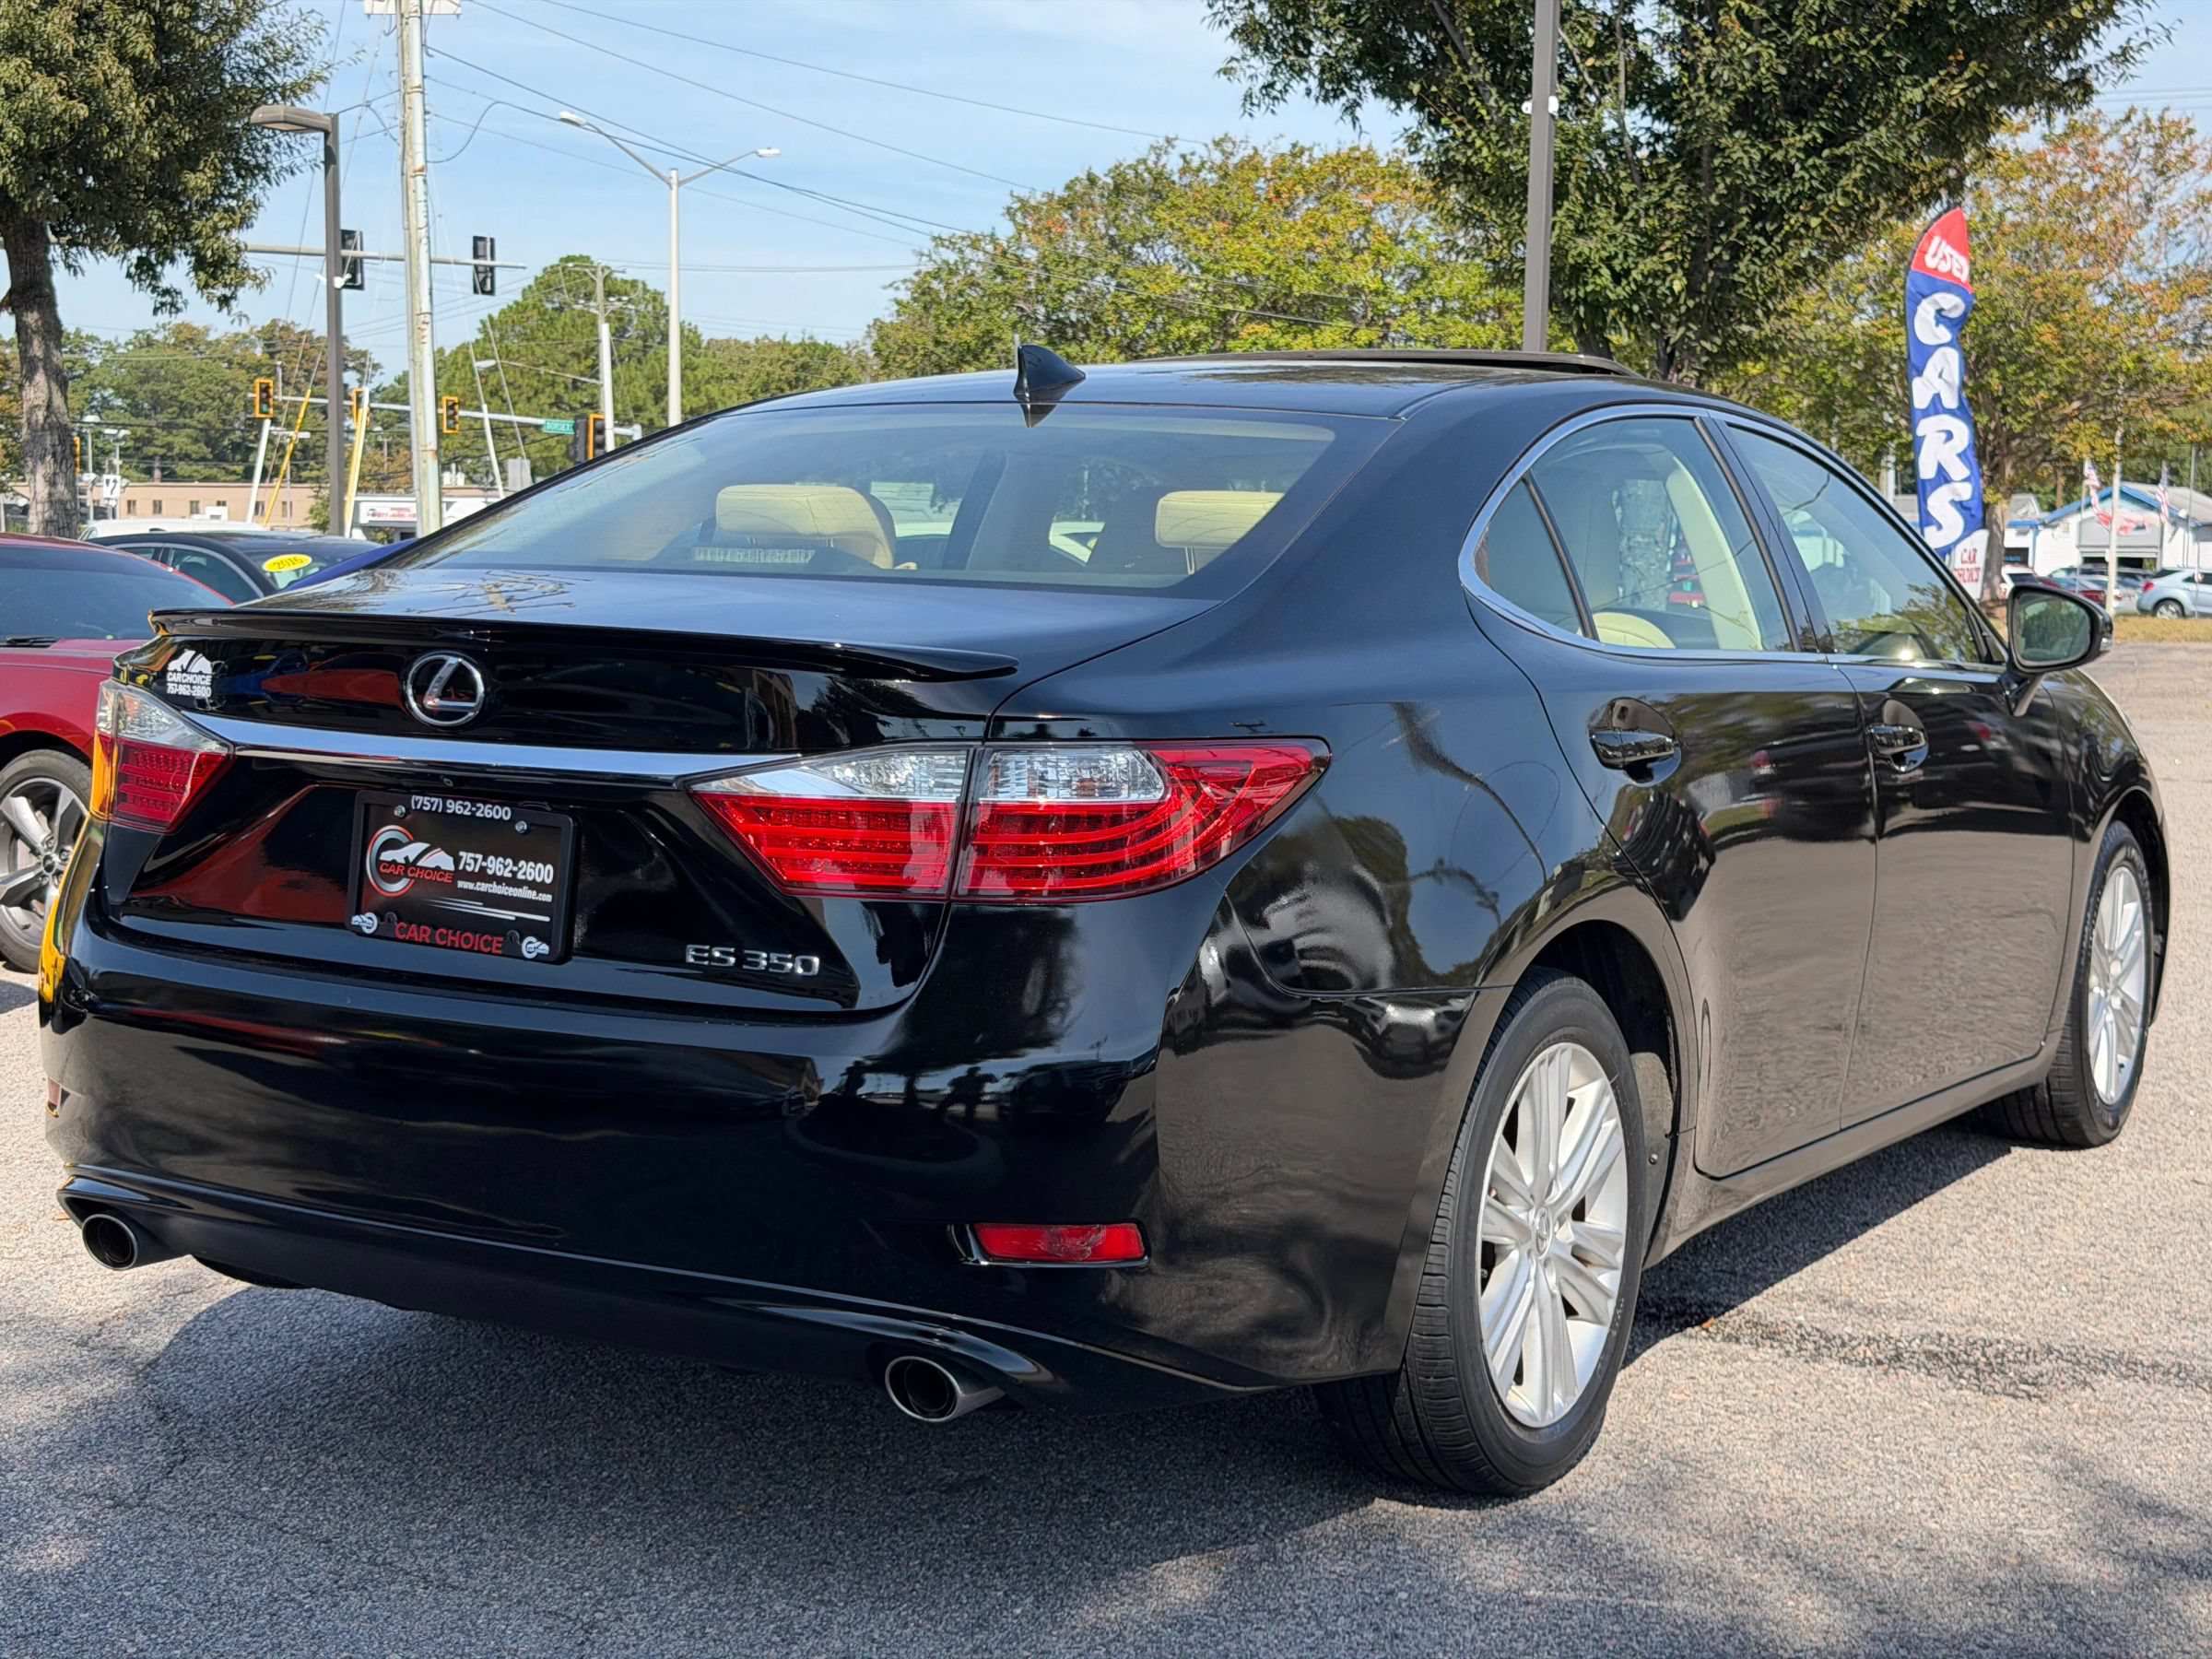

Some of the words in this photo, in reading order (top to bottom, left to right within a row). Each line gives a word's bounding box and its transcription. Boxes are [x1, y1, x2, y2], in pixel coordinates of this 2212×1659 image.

[1912, 291, 1973, 550] CARS
[167, 672, 182, 683] CAR
[182, 673, 212, 685] CHOICE
[167, 683, 212, 698] 757-962-2600
[411, 794, 442, 813] (757)
[446, 799, 512, 820] 962-2600
[380, 863, 406, 876] CAR
[407, 865, 454, 884] CHOICE
[458, 851, 554, 885] 757-962-2600
[456, 879, 553, 902] www.carchoiceonline.com
[394, 922, 431, 944] CAR
[434, 928, 505, 954] CHOICE
[686, 944, 736, 967] ES
[742, 949, 820, 976] 350
